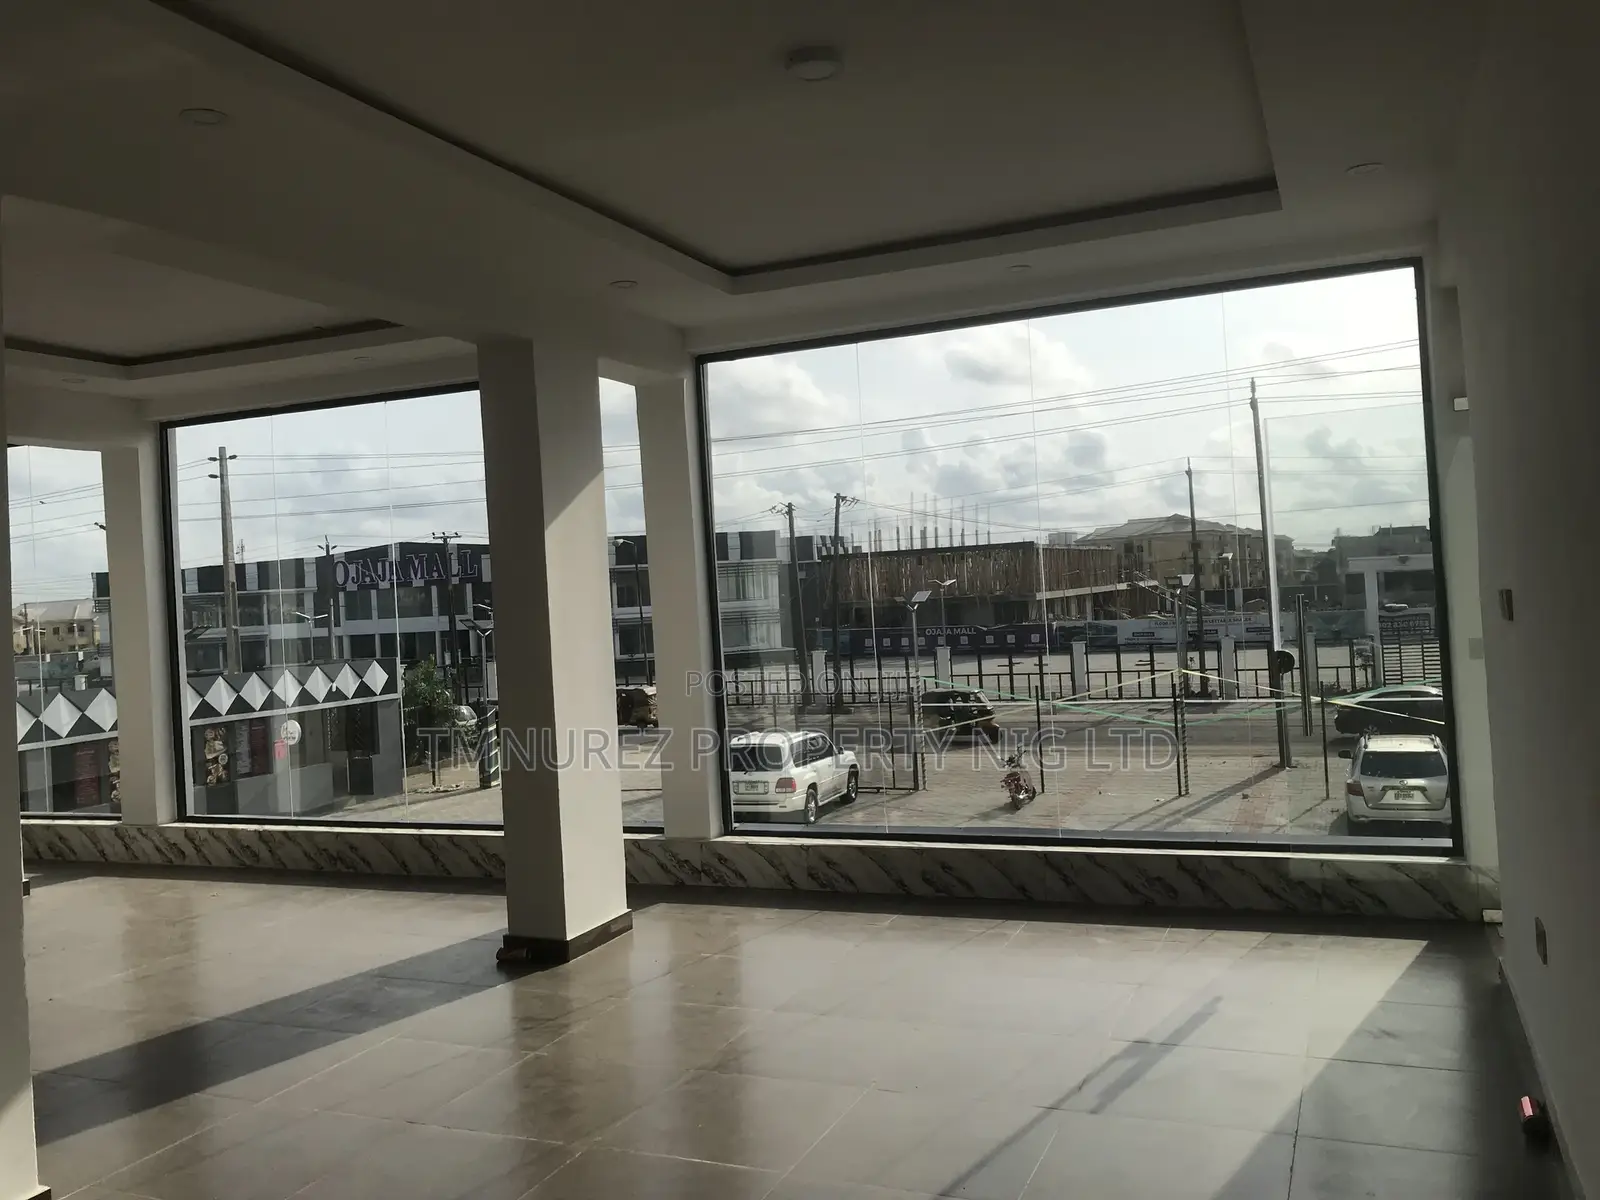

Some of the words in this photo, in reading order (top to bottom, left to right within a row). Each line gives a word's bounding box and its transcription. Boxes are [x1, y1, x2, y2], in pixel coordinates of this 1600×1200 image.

[333, 558, 404, 587] OJAJA
[406, 550, 478, 581] MALL
[953, 627, 977, 635] MALL
